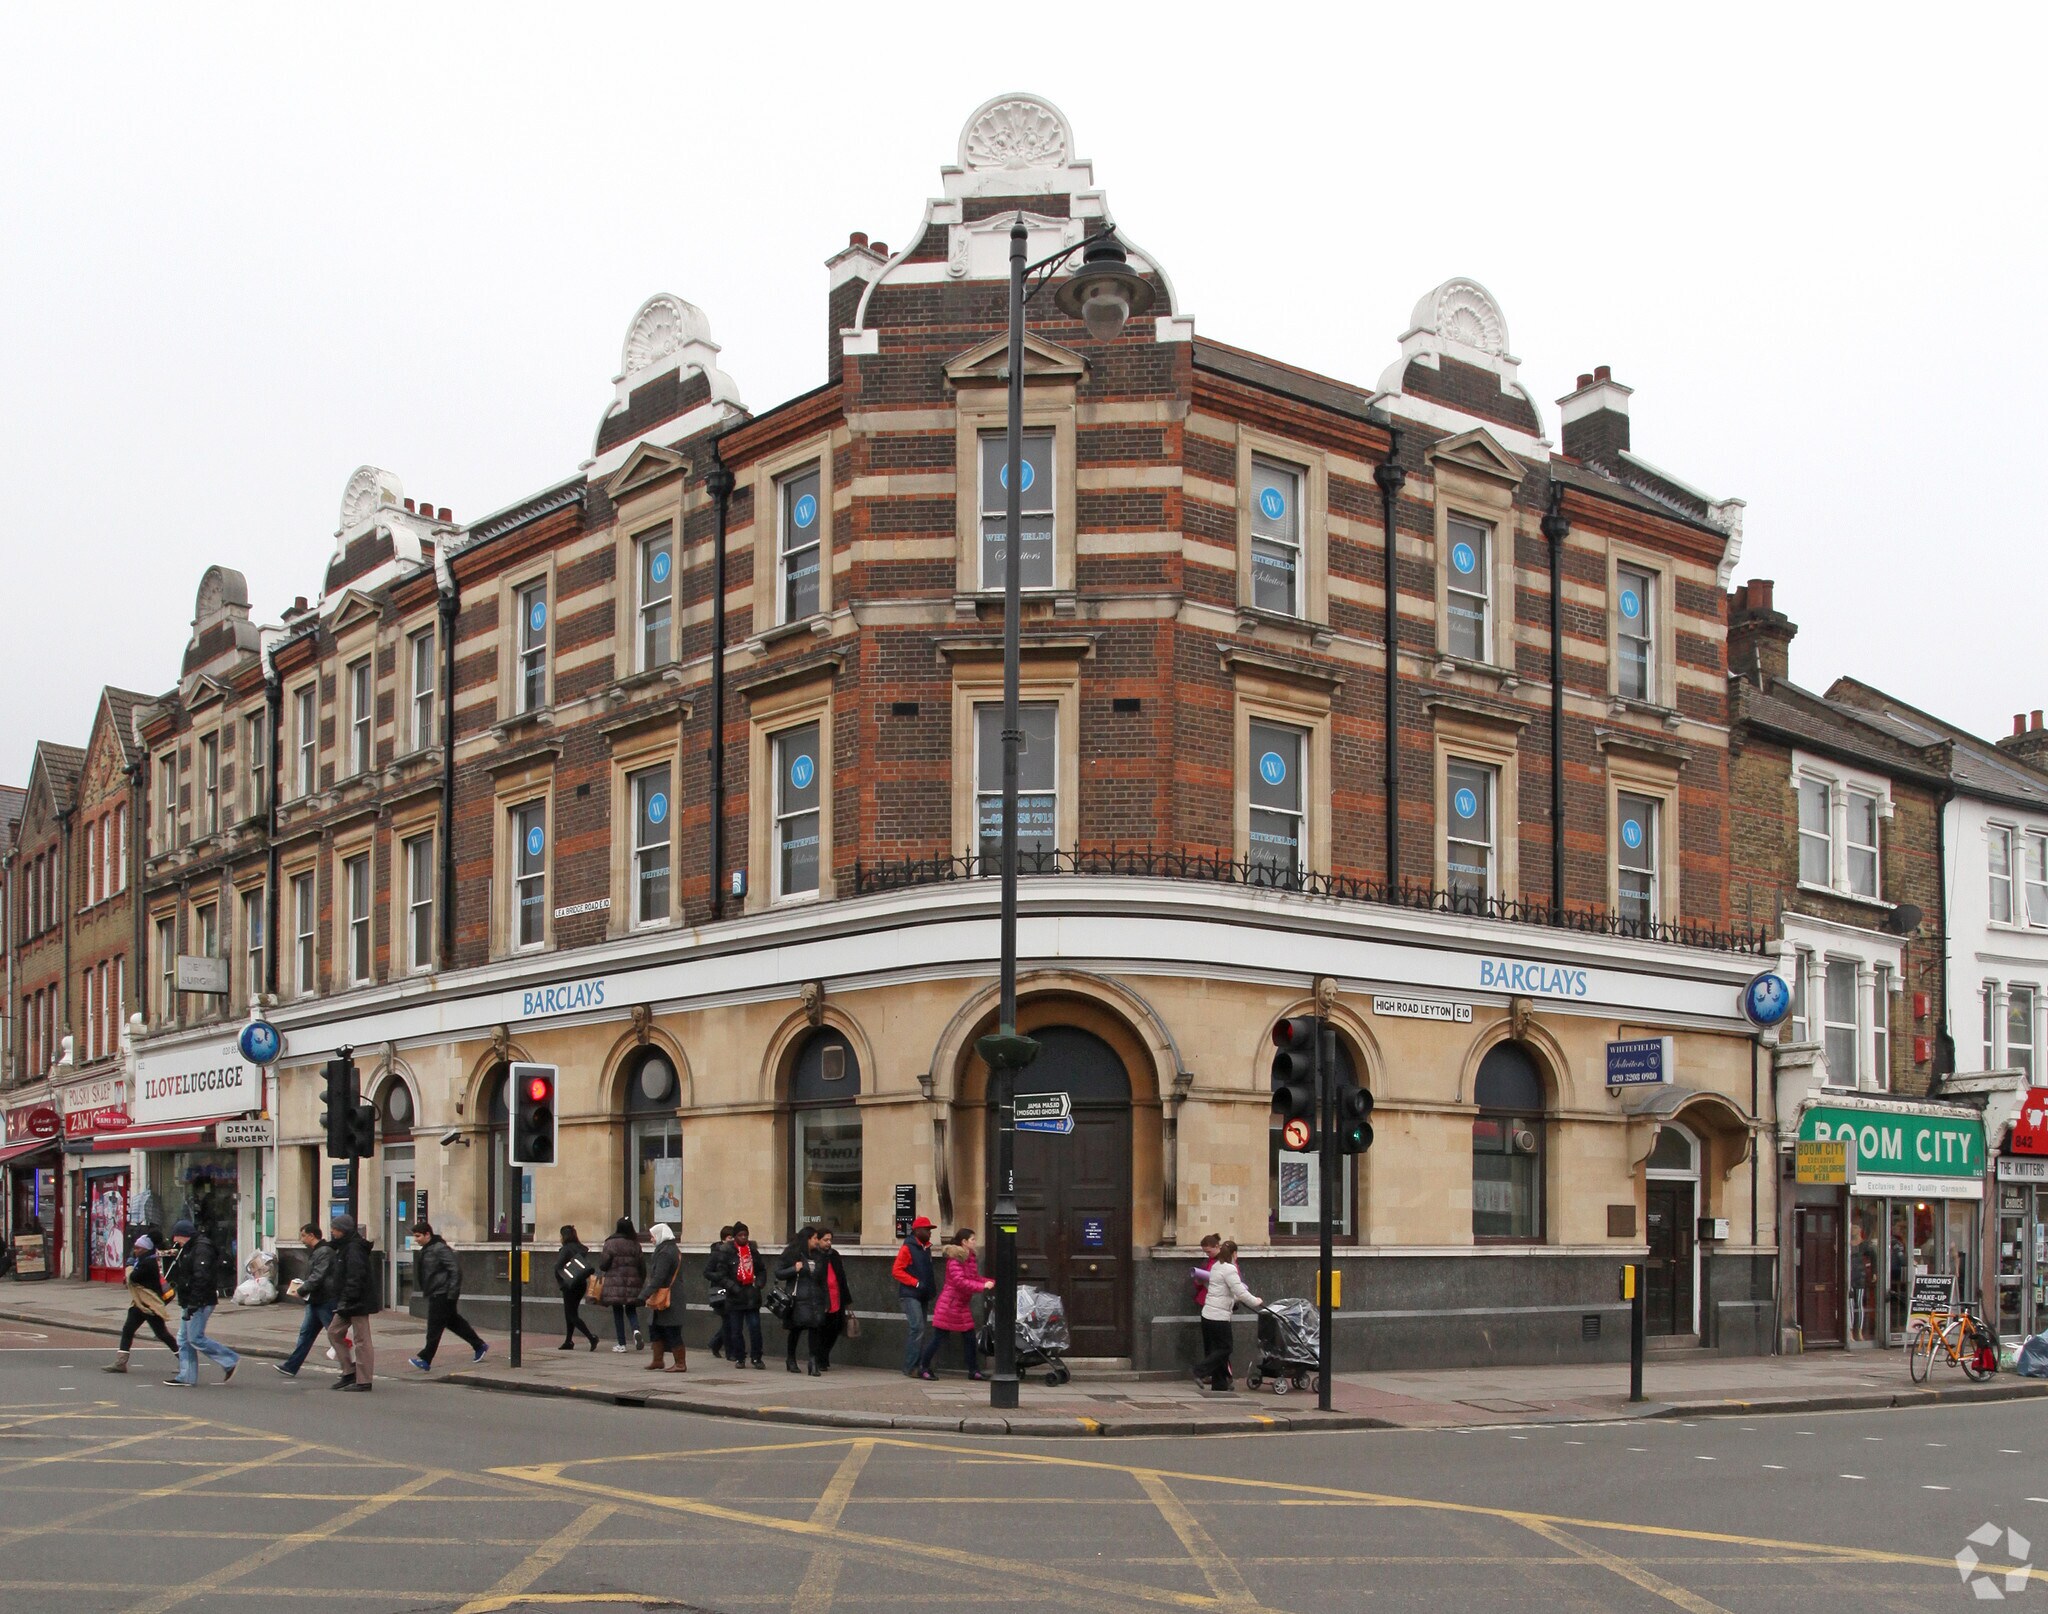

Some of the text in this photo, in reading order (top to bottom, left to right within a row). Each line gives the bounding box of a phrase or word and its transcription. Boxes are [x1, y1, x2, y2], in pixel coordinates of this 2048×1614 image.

[555, 908, 565, 918] LEA
[565, 905, 584, 915] BRIDGE
[585, 902, 599, 911] ROAD
[1480, 960, 1587, 996] BARCLAYS
[523, 981, 605, 1015] BARCLAYS
[1376, 1001, 1451, 1017] HIGH ROAD LEYTON
[1610, 1043, 1660, 1053] WHITEFIELDS
[1612, 1074, 1624, 1082] 020
[227, 1126, 266, 1134] DENTAL
[225, 1135, 270, 1143] SURGERY
[1798, 1143, 1845, 1155] BOOM CITY
[1916, 1129, 1972, 1164] CITY
[2000, 1162, 2045, 1177] THE KNITTERS
[1868, 1182, 1968, 1193] Exclusive Best Quality Garments
